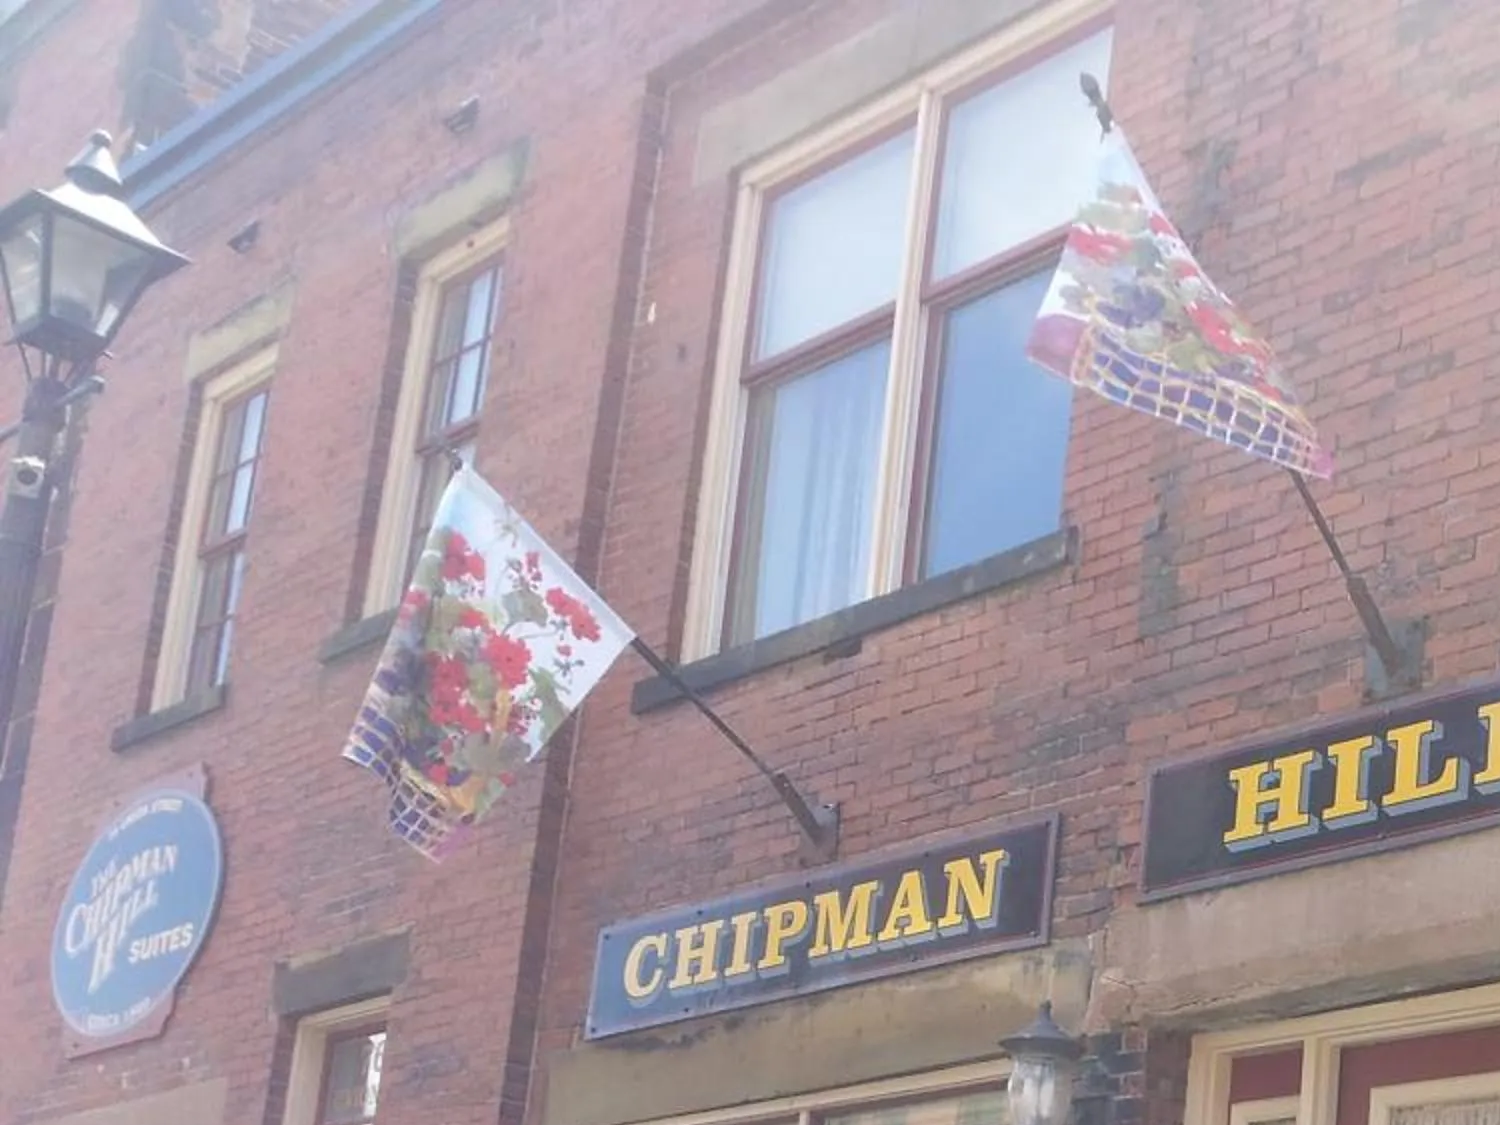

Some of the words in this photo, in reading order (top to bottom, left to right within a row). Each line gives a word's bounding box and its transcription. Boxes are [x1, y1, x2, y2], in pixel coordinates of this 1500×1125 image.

[88, 880, 159, 994] HILL
[127, 922, 193, 965] SUITES
[623, 849, 1009, 1004] CHIPMAN
